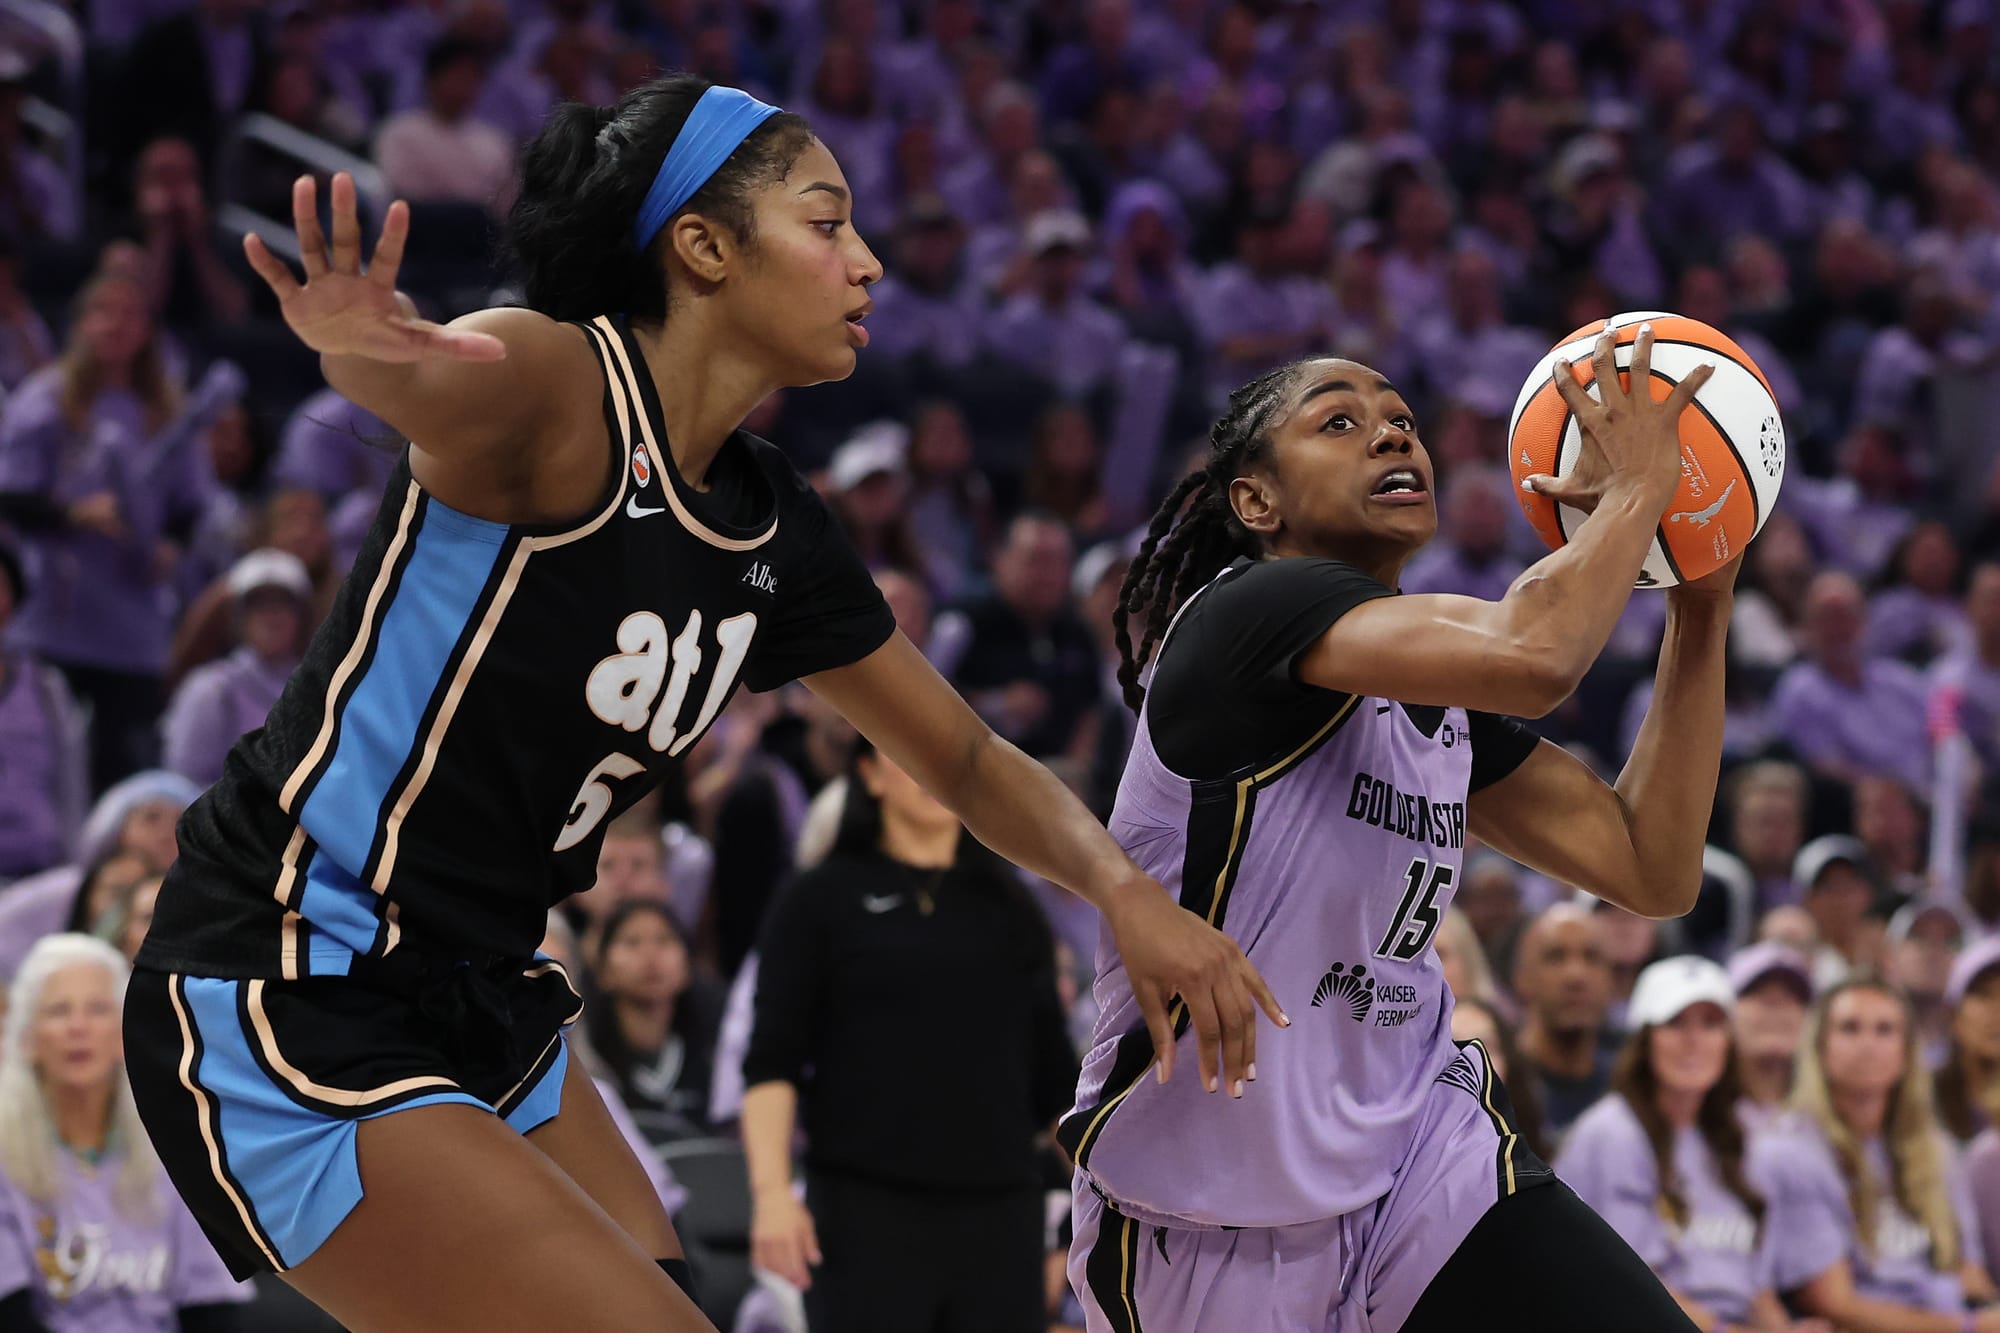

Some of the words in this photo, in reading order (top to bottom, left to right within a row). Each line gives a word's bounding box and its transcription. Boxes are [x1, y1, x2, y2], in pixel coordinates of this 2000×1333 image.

[552, 751, 647, 852] 5
[1345, 772, 1435, 845] GOLDEN
[1373, 856, 1454, 963] 15
[1376, 985, 1417, 1003] KAISER
